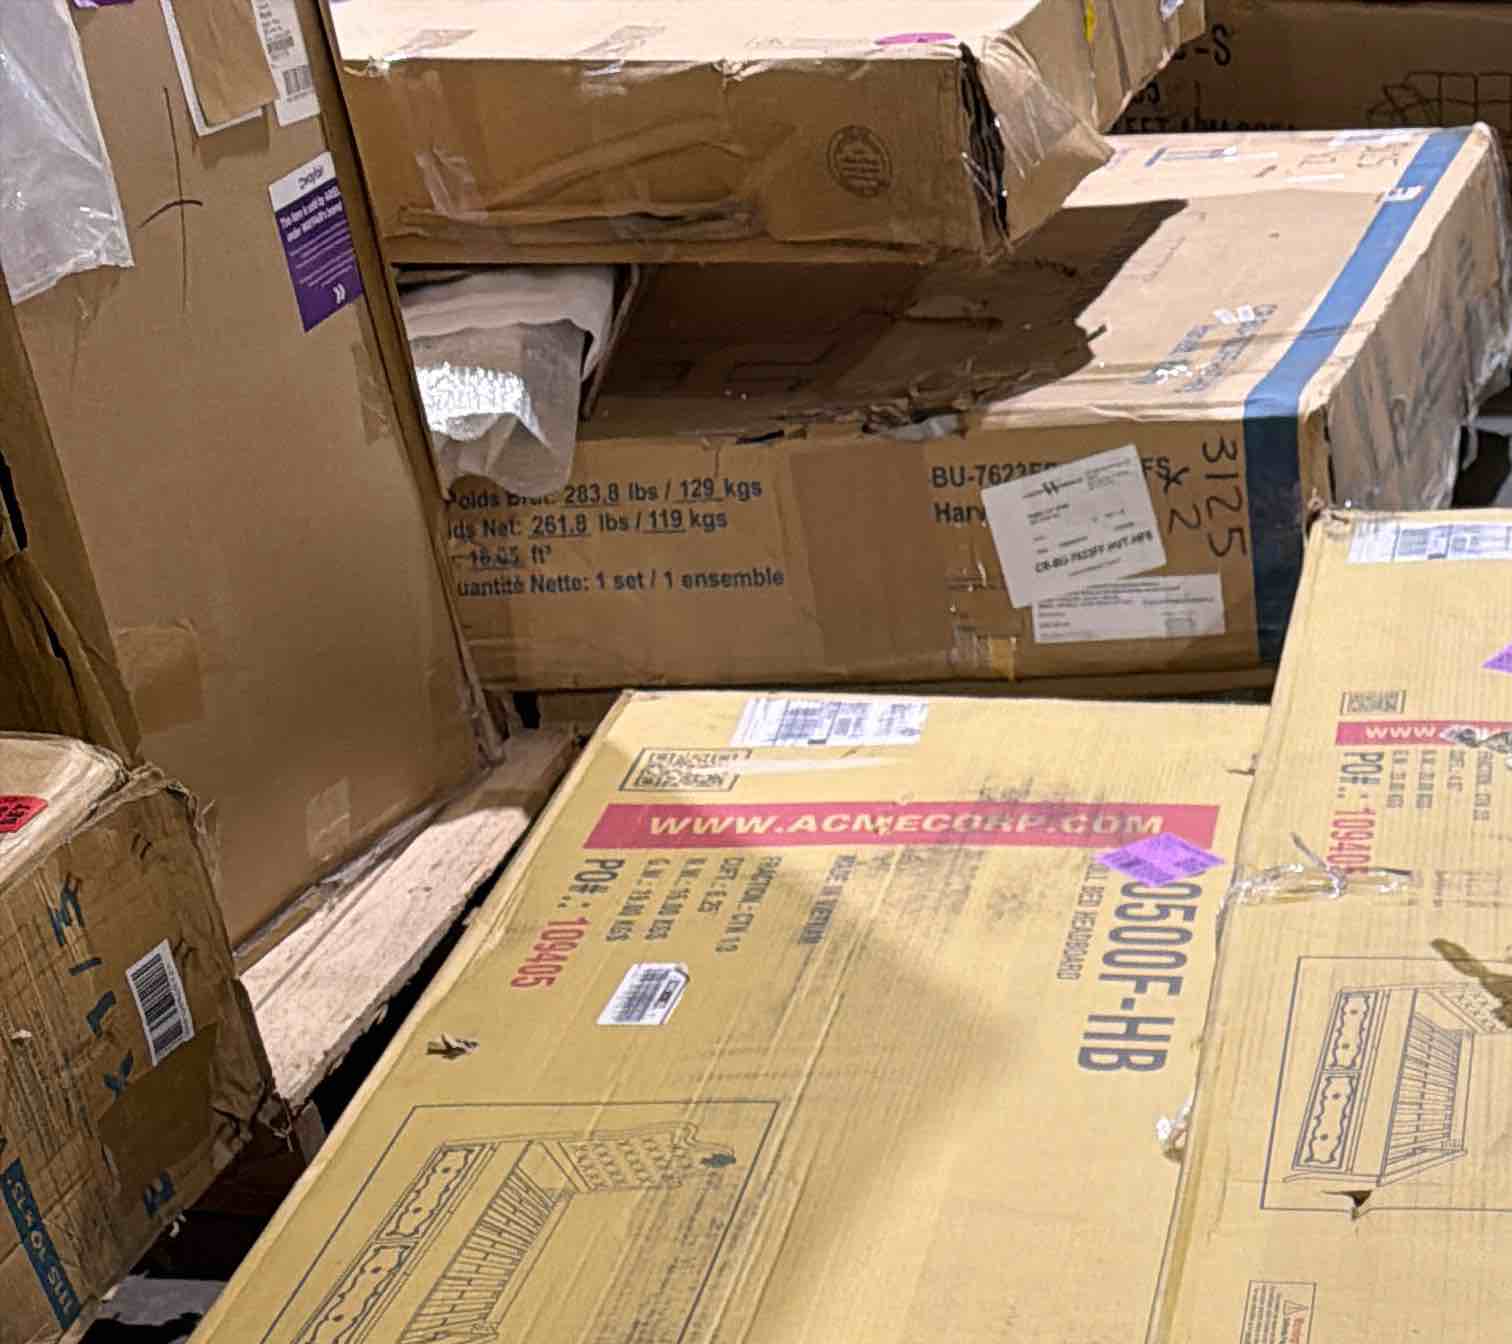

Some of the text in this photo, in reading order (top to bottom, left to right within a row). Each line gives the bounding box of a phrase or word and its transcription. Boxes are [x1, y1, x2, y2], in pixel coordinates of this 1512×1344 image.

[629, 481, 659, 501] lbs
[680, 478, 714, 498] 129
[724, 478, 762, 502] kgs
[1202, 437, 1248, 556] 3125
[599, 511, 628, 532] lbs
[648, 508, 683, 529] 119
[689, 508, 728, 533] kgs
[680, 566, 784, 590] ensemble
[649, 812, 1166, 838] WWW.ACMECORP.COM
[1326, 806, 1377, 874] 10940
[510, 916, 592, 988] 109405
[1078, 870, 1204, 1073] 0500F-HB
